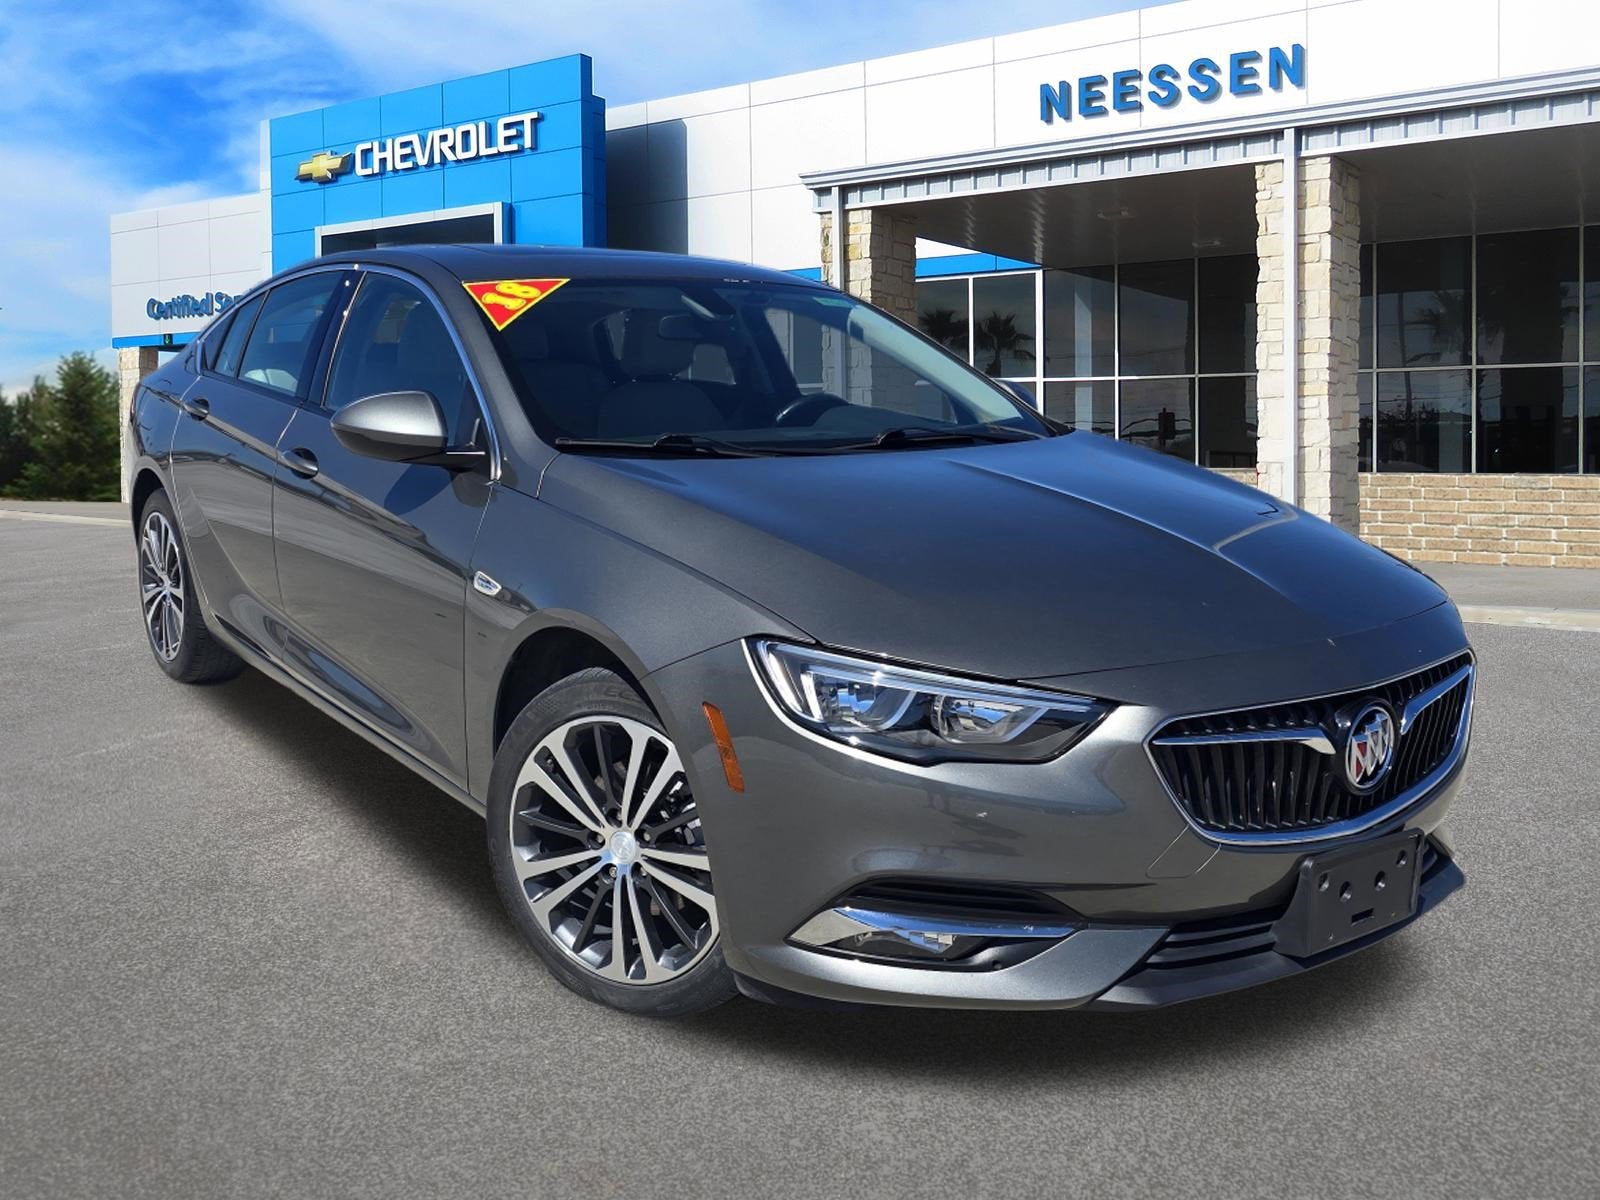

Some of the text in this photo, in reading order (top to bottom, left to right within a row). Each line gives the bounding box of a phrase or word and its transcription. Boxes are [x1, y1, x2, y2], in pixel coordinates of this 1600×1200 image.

[1040, 43, 1305, 124] NEESSEN
[354, 111, 542, 176] CHEVROLET
[147, 292, 213, 320] Certified
